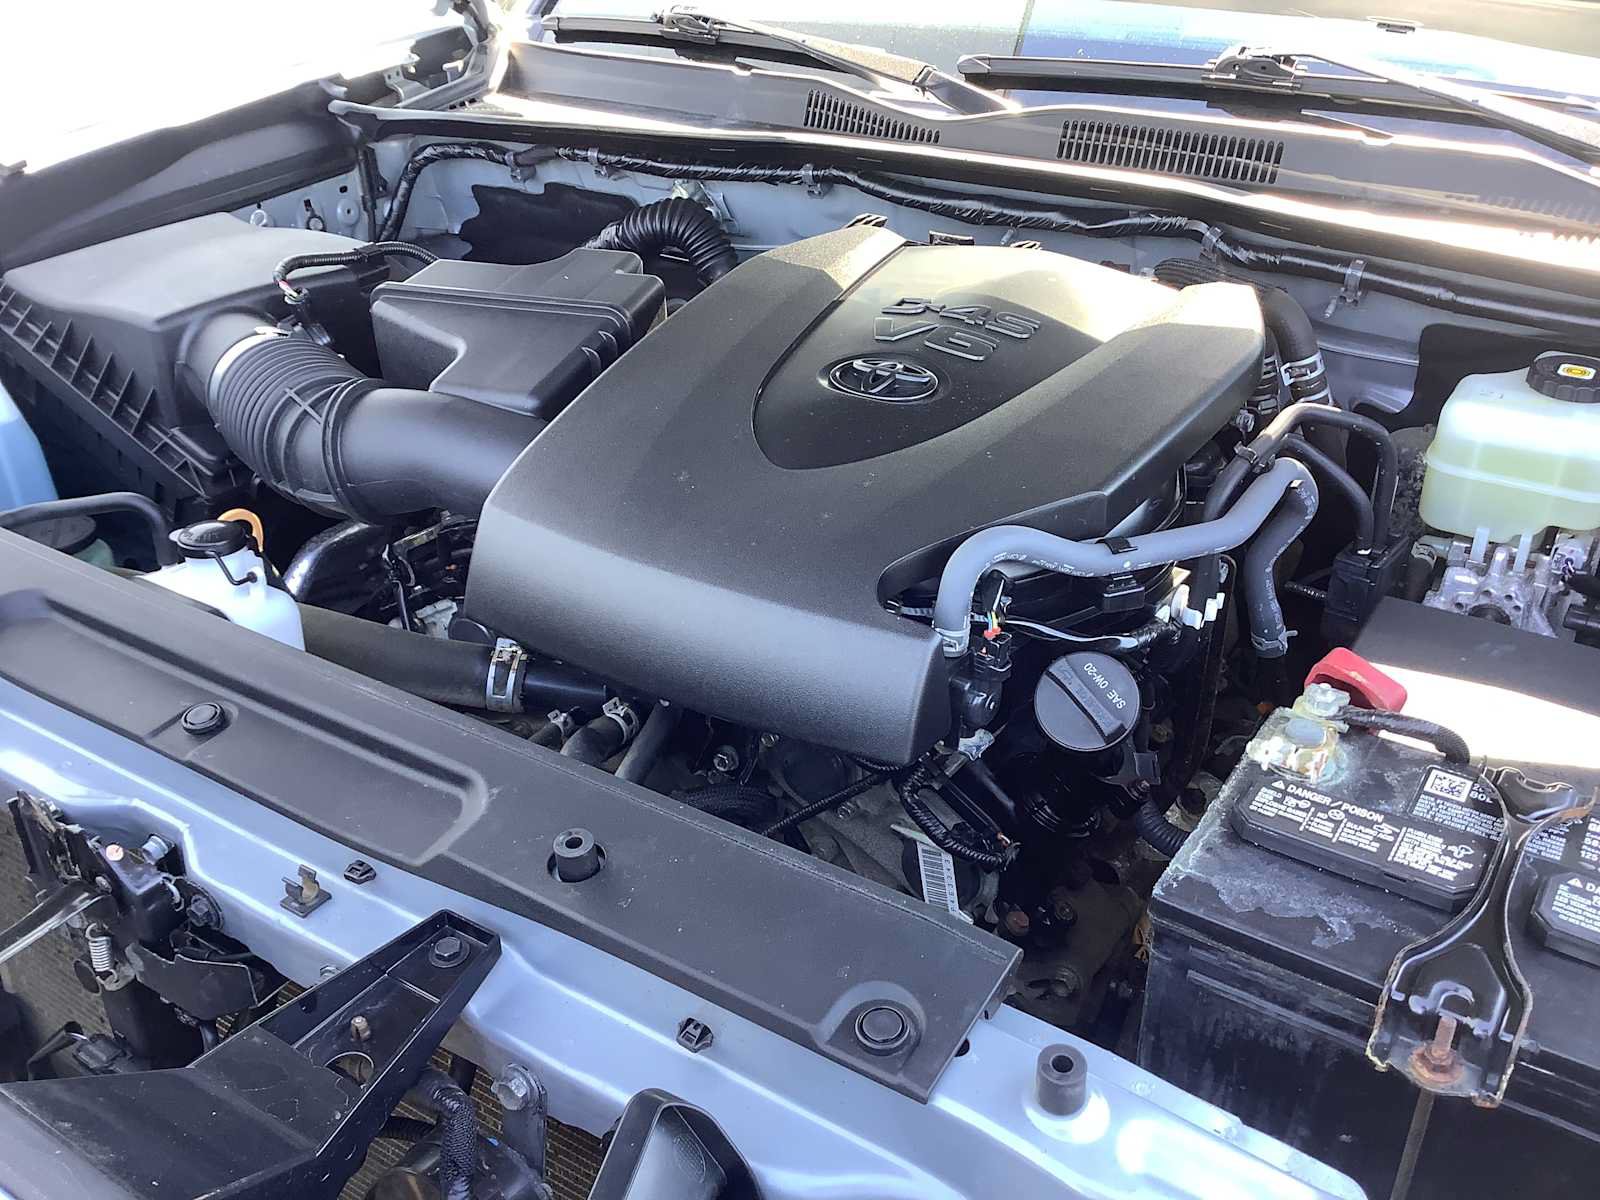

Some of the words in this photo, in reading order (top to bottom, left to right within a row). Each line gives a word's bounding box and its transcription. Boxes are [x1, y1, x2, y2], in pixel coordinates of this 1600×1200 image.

[874, 316, 1001, 361] V6
[1083, 662, 1109, 689] 0W-20
[1107, 689, 1126, 709] SAE
[1286, 784, 1332, 806] DANGER
[1341, 803, 1385, 823] POISON
